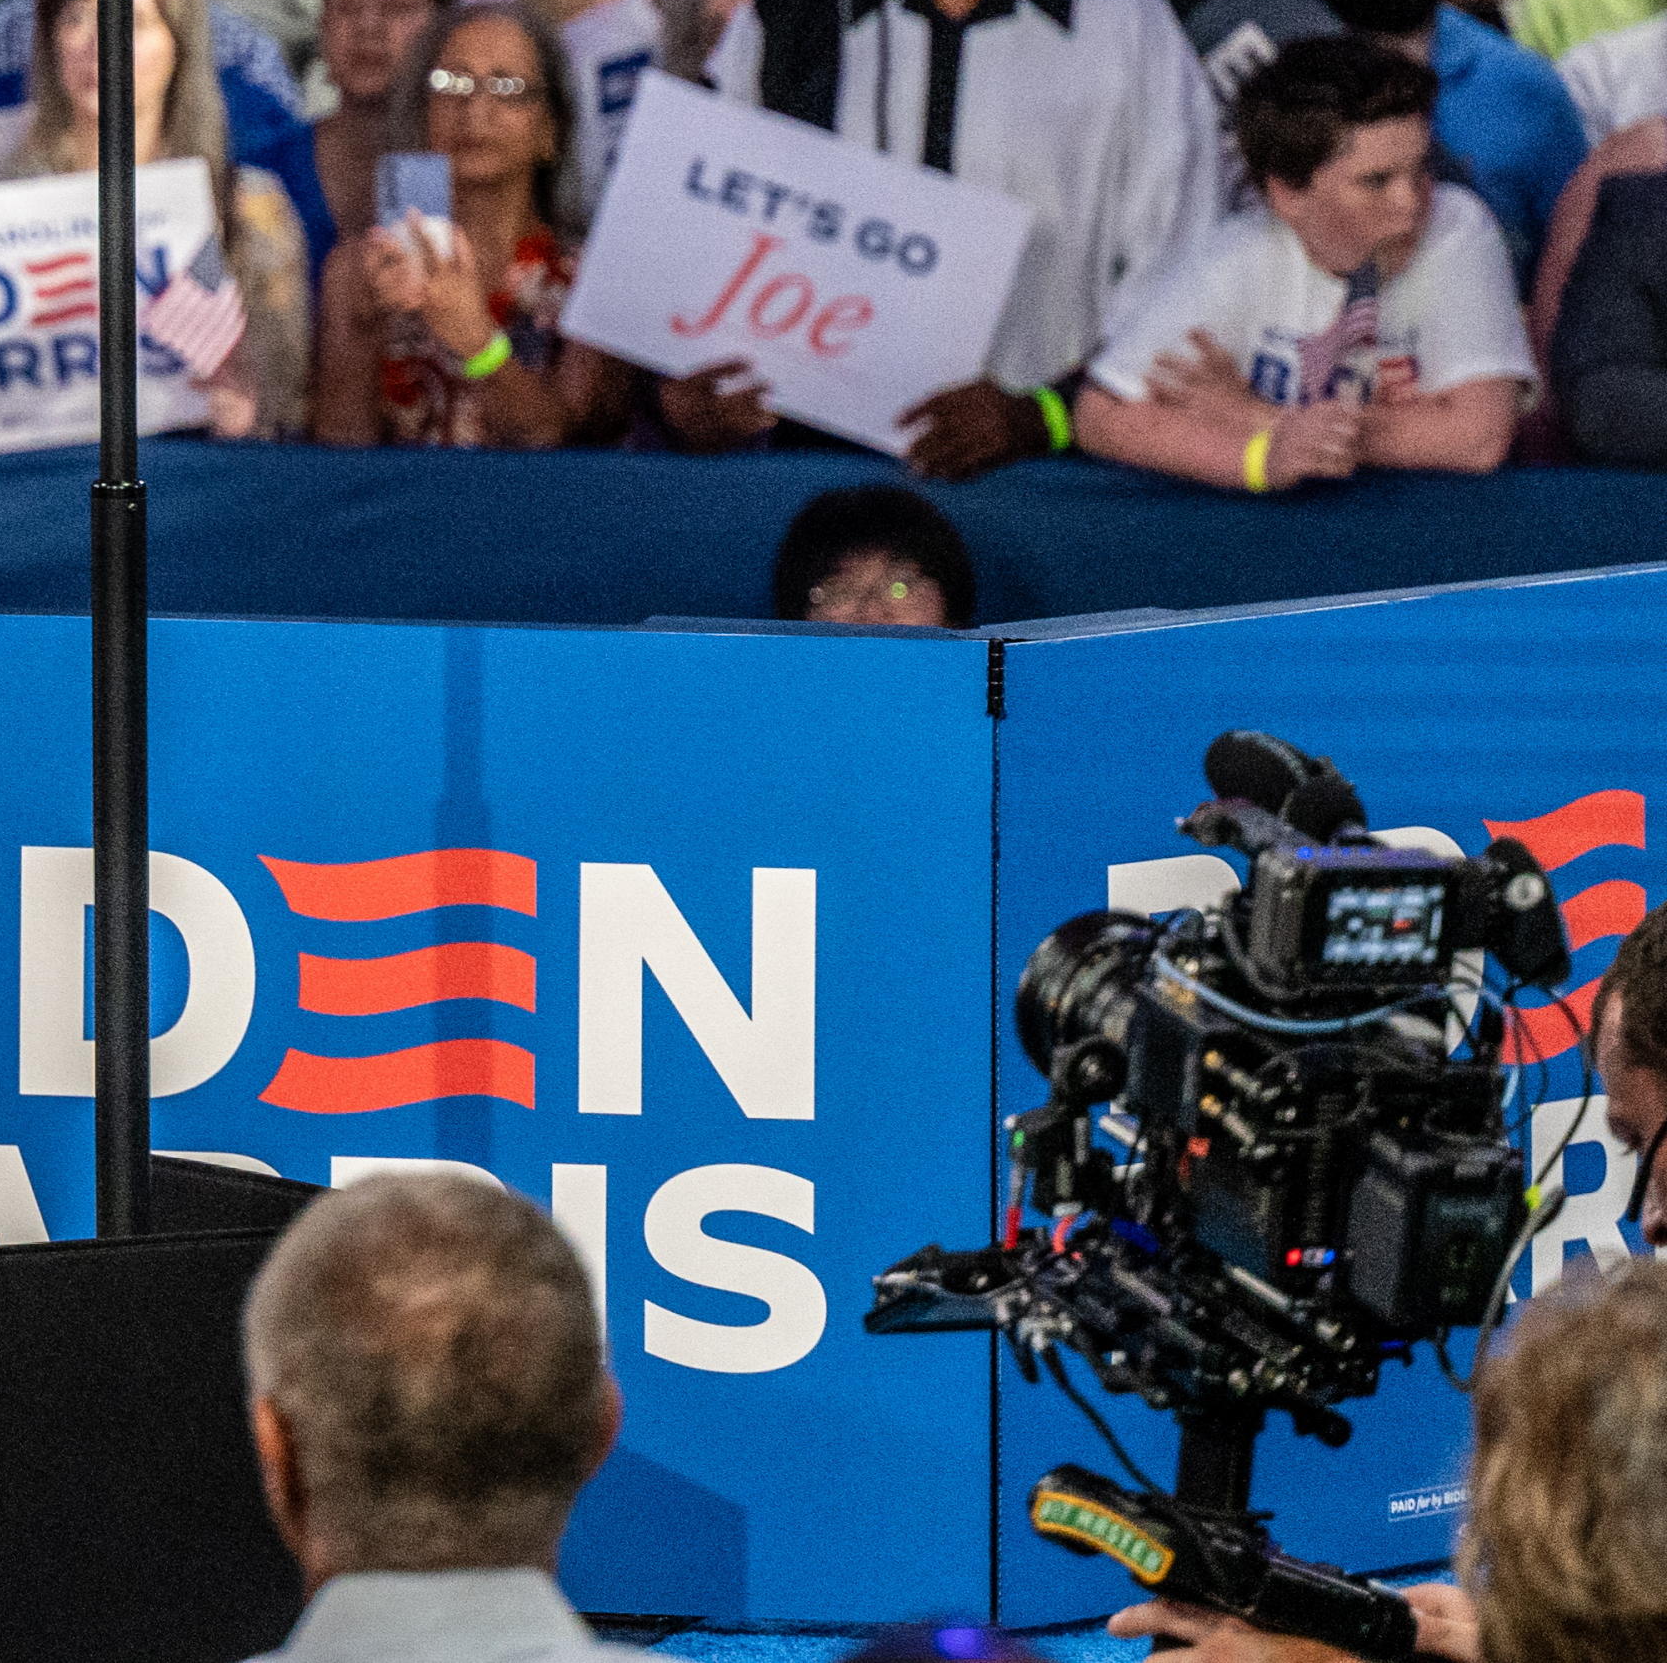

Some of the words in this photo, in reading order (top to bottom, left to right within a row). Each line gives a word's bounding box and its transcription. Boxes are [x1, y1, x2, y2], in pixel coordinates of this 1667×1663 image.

[684, 157, 843, 243] LET'S
[851, 216, 941, 278] GO
[669, 230, 875, 357] Joe
[1390, 1497, 1416, 1514] PAID
